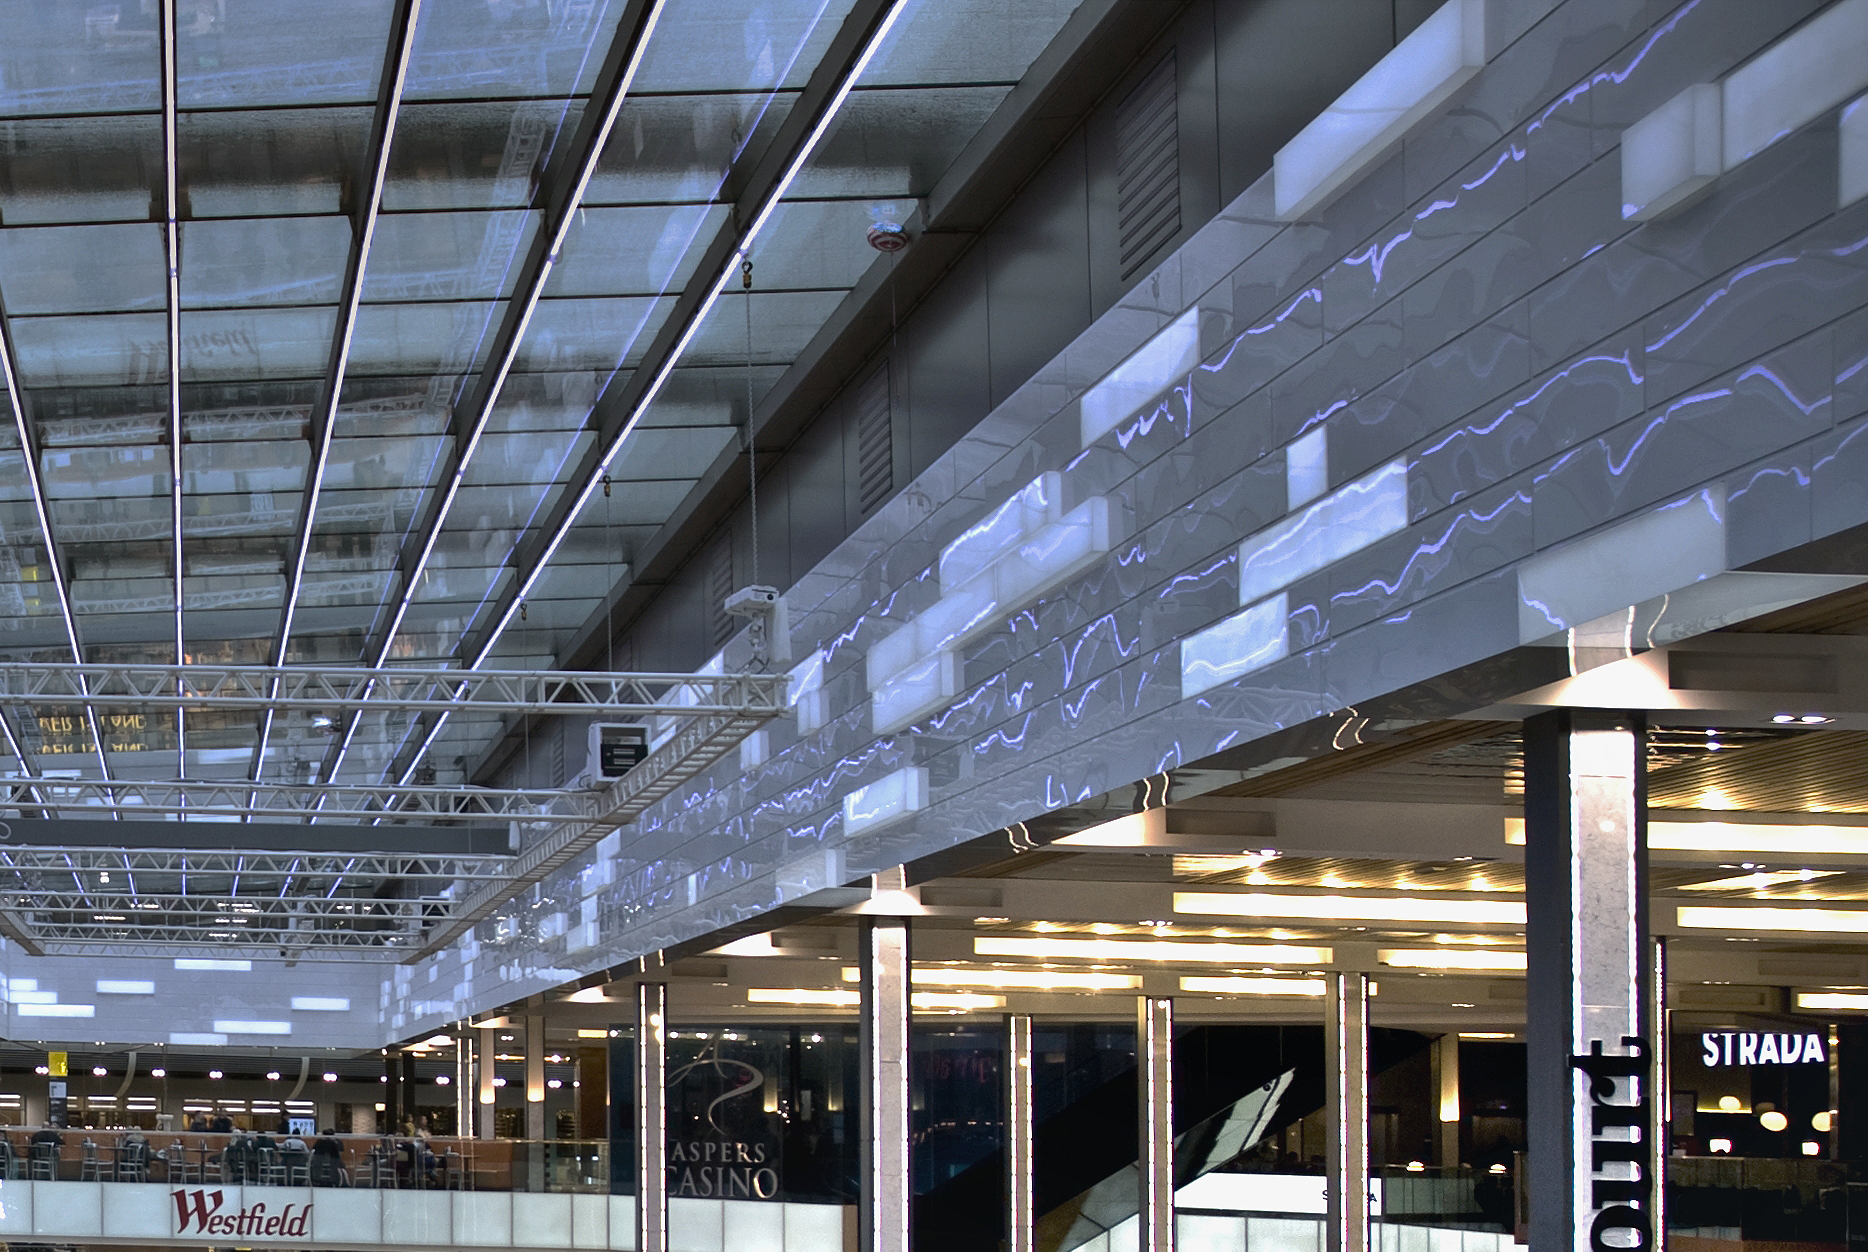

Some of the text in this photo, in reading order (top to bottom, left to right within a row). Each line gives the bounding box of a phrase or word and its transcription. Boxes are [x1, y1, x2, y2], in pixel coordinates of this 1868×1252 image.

[1702, 1033, 1825, 1067] STRADA
[672, 1142, 765, 1163] ASPERS
[668, 1166, 778, 1198] CASINO
[170, 1188, 314, 1237] Westfield
